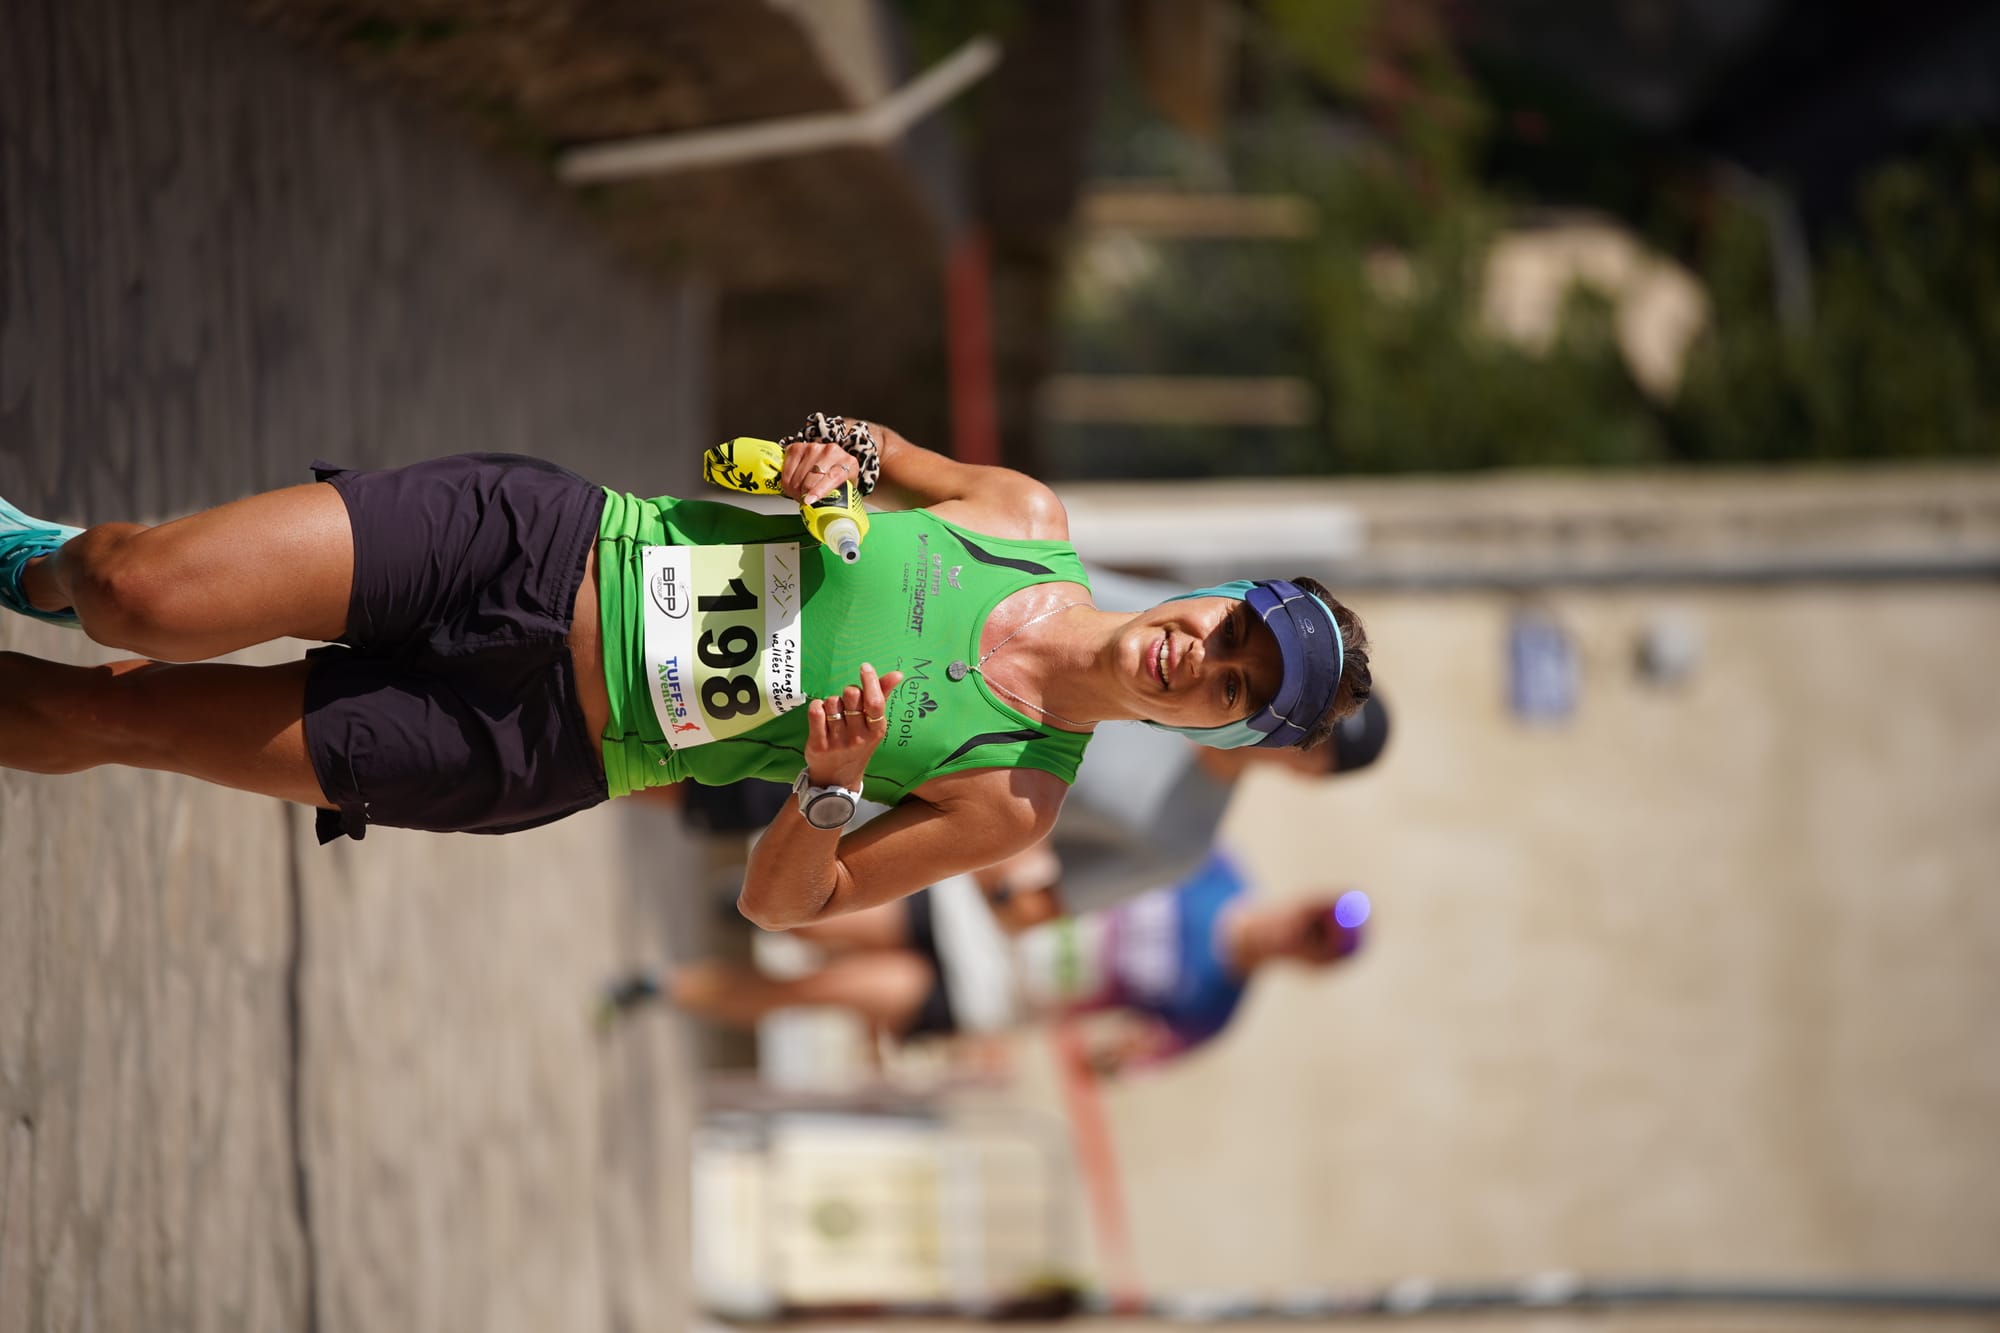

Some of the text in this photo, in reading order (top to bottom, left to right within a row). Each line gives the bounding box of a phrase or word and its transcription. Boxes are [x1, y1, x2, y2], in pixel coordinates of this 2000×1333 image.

[663, 566, 676, 611] BFP
[911, 545, 928, 634] INTERSPORT
[696, 578, 761, 721] 198
[772, 633, 782, 674] vallées
[782, 639, 795, 700] Challenge
[657, 663, 678, 724] Aventure
[665, 656, 688, 718] TUFF'S
[898, 658, 932, 748] Marvejols
